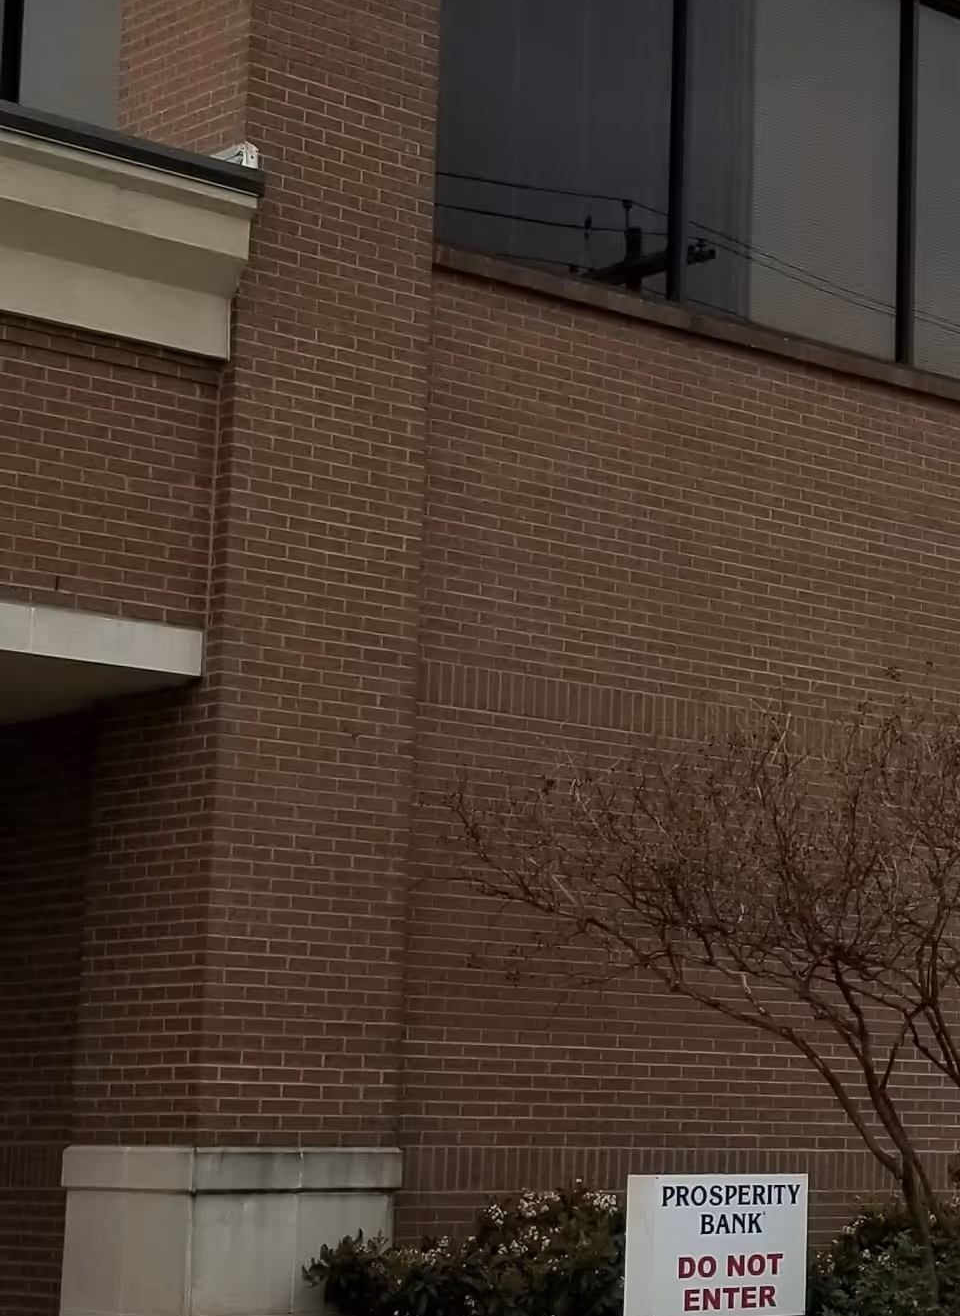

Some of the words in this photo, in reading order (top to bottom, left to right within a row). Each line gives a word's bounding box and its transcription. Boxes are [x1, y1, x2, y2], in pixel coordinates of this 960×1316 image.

[661, 1183, 801, 1207] PROSPERITY
[700, 1212, 763, 1235] BANK
[678, 1255, 717, 1279] DO
[727, 1253, 783, 1277] NOT
[684, 1285, 777, 1312] ENTER
